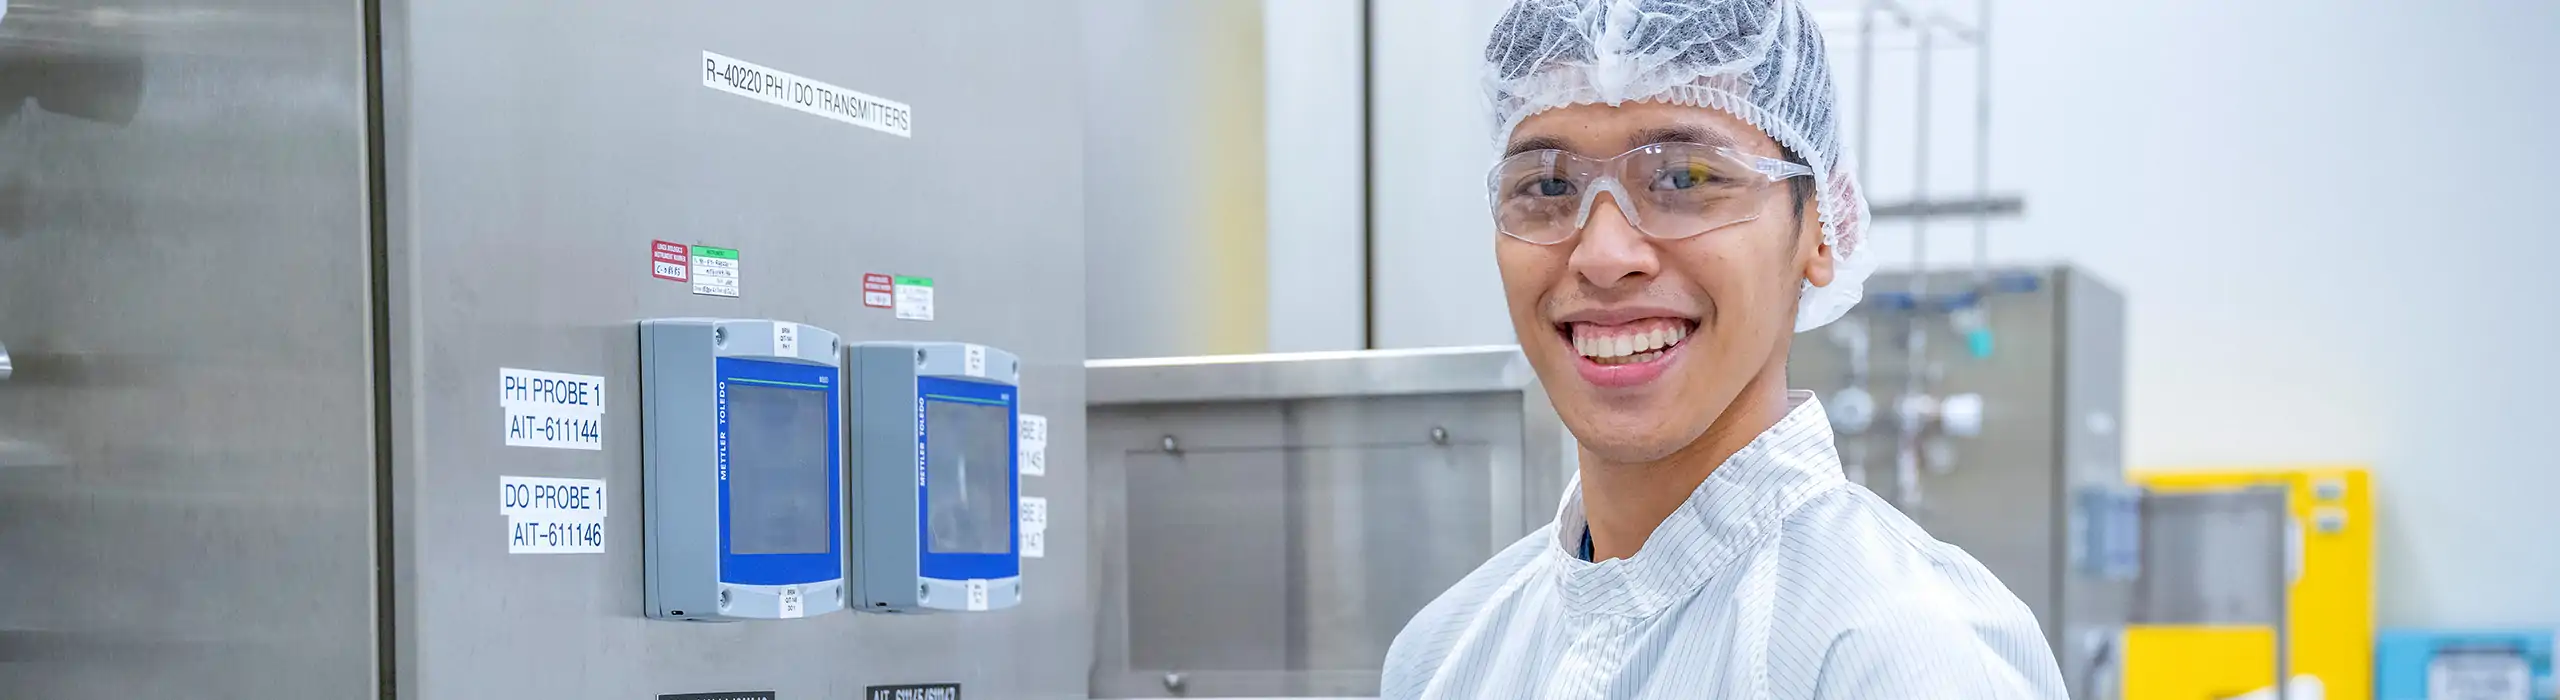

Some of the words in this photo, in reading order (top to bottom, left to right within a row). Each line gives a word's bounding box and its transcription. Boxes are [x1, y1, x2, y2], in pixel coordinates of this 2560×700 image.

[706, 58, 762, 93] R-40220
[765, 74, 783, 100] PH
[786, 79, 792, 101] /
[795, 82, 813, 107] DO
[817, 88, 909, 131] TRANSMITTERS
[505, 376, 527, 400] PH
[533, 378, 588, 405] PROBE
[594, 383, 600, 406] 1
[510, 415, 599, 443] AIT-611144
[505, 484, 530, 508] DO
[535, 485, 590, 509] PROBE
[595, 487, 601, 510] 1
[513, 522, 602, 547] AIT-611146
